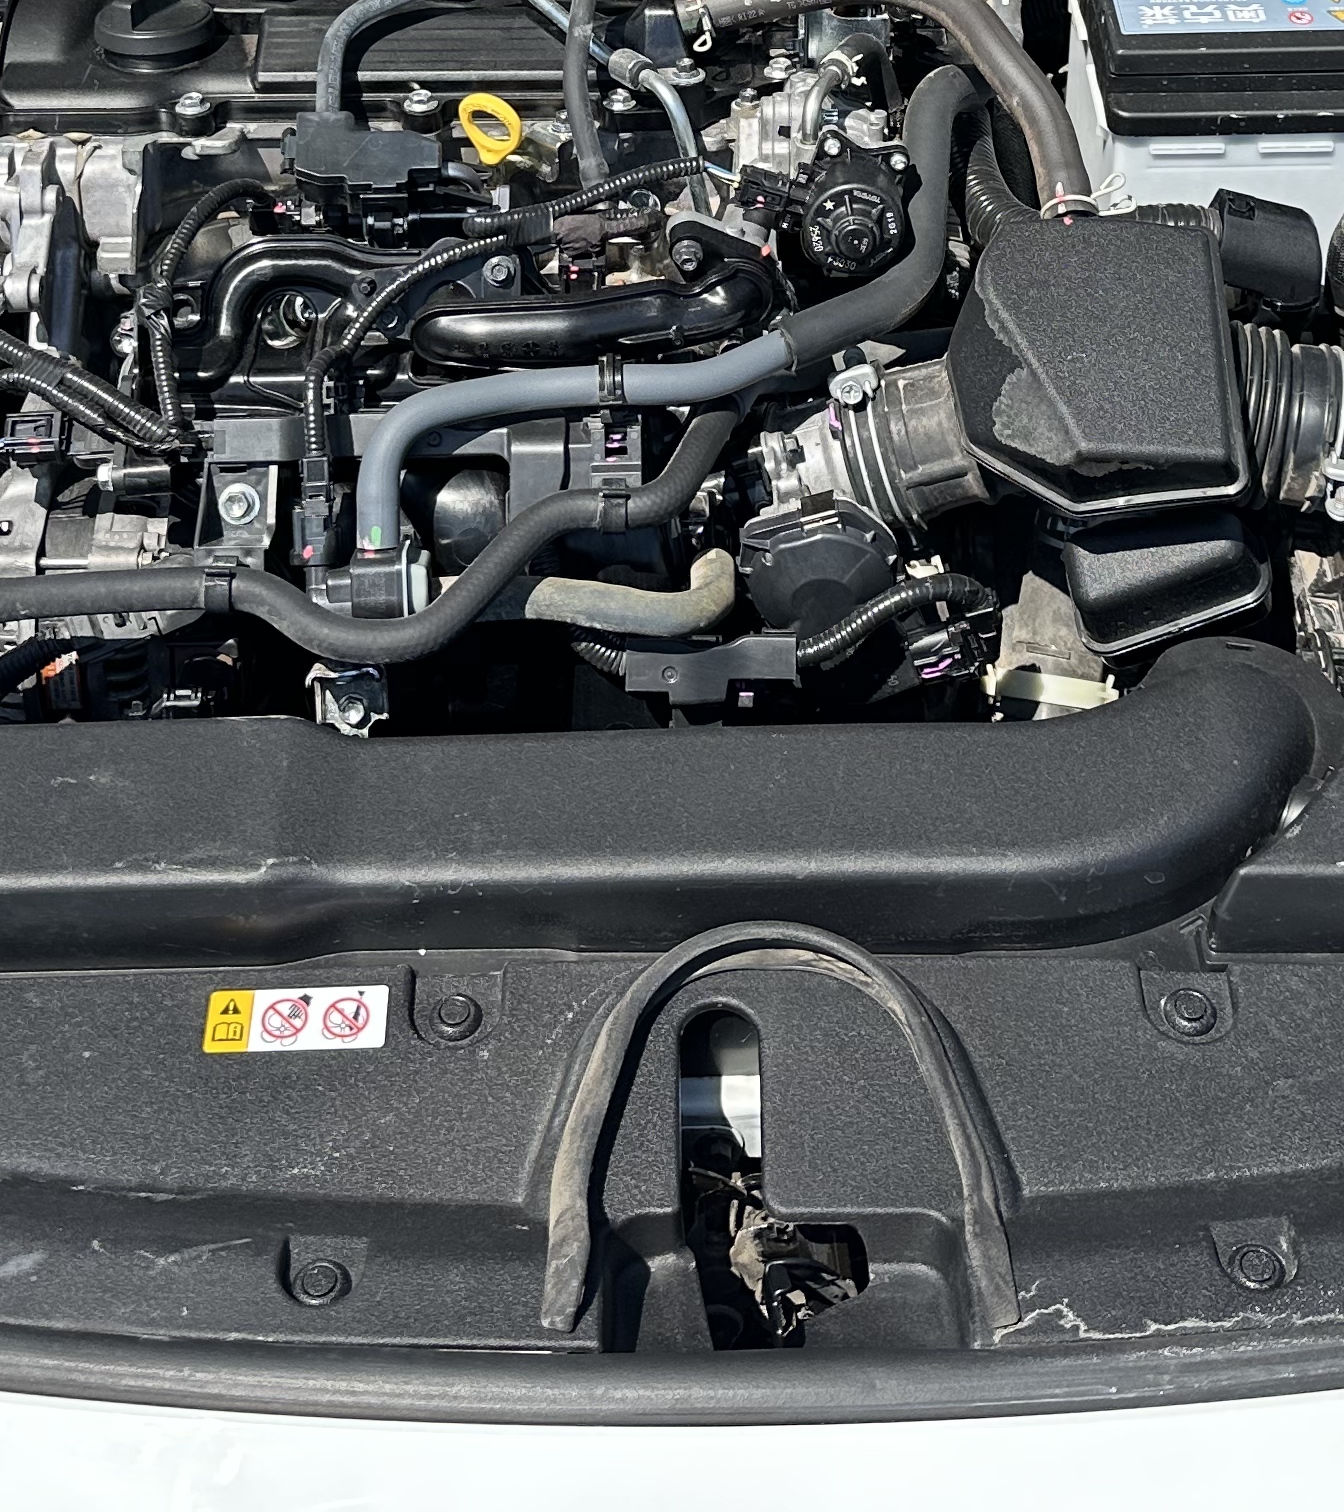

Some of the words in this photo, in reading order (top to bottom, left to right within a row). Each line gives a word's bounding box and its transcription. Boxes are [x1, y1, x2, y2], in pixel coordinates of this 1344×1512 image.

[1137, 3, 1267, 25] 奥克莱
[809, 226, 824, 252] 25620
